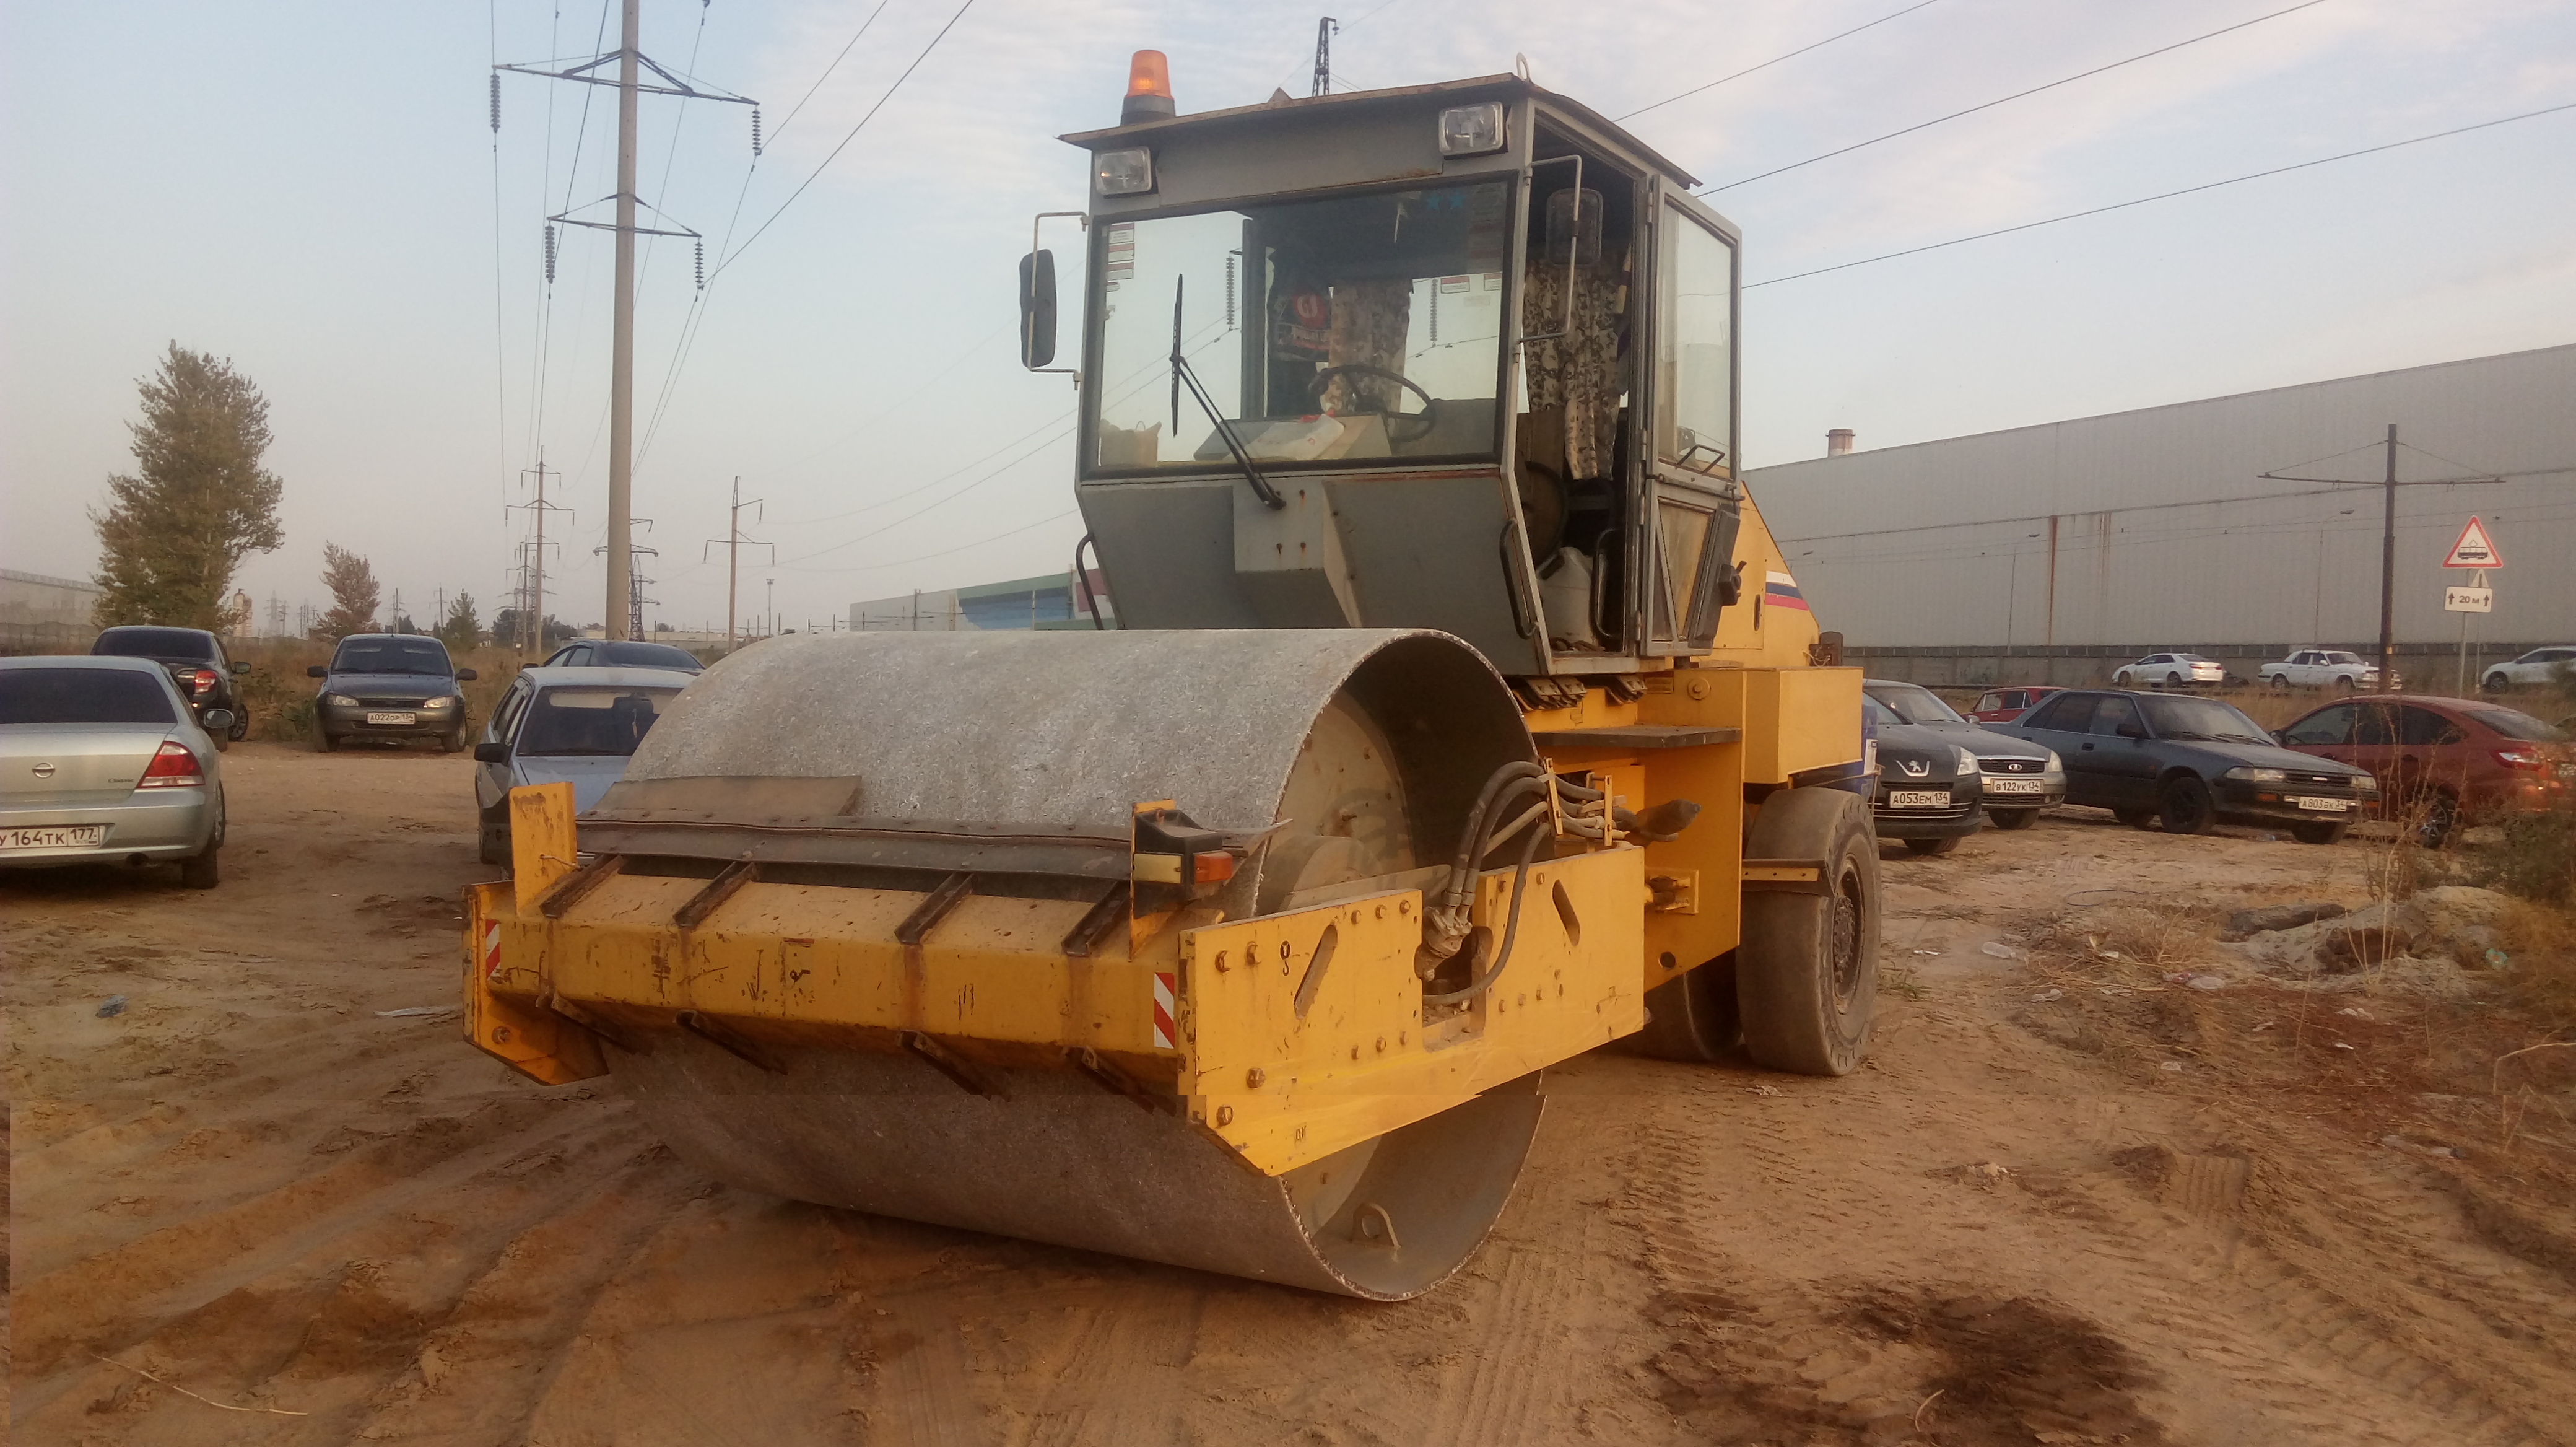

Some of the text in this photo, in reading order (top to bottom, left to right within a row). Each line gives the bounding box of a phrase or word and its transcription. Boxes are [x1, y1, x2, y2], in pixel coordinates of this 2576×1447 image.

[2459, 595, 2471, 603] 20
[1892, 792, 1948, 804] А053ЕМ 134
[69, 828, 94, 840] 177
